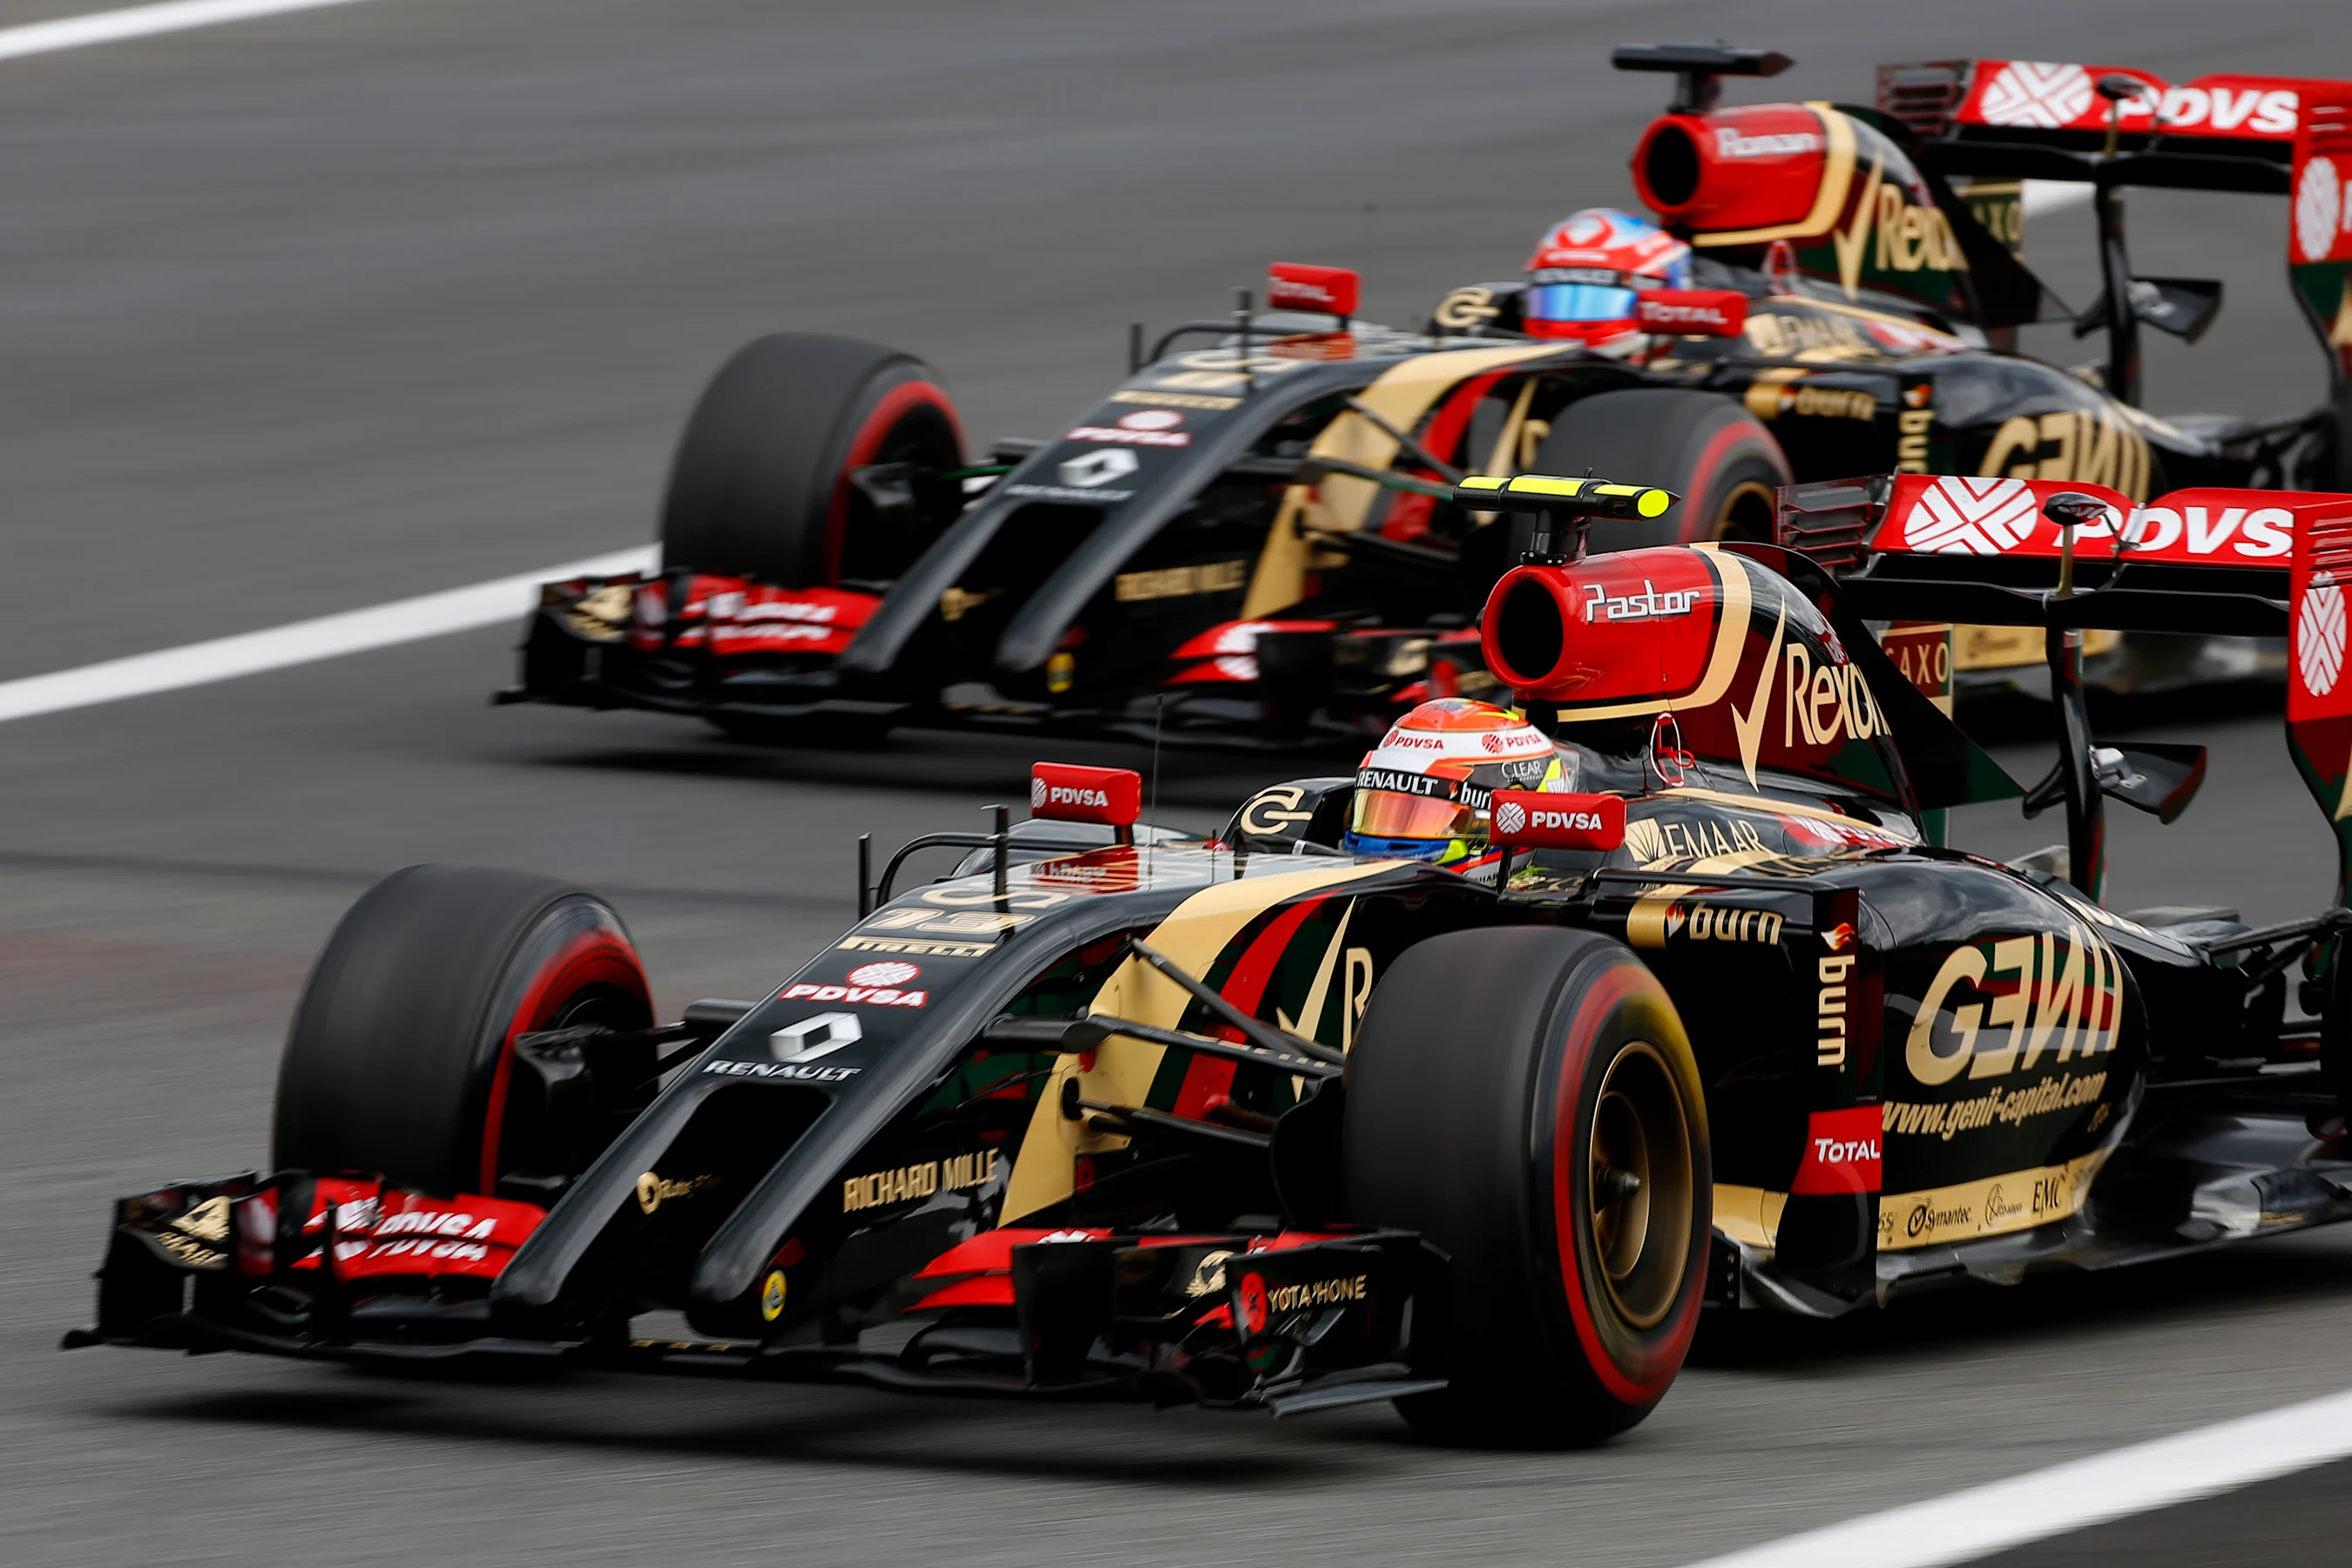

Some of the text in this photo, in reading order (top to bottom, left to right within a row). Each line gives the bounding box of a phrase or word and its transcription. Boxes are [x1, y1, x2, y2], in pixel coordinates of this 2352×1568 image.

[1639, 301, 1728, 324] TOTAL
[2051, 504, 2295, 558] PDVS
[1583, 579, 1700, 622] Pastor
[1885, 641, 1950, 685] AXO
[1395, 736, 1443, 750] PDVSA
[1506, 733, 1541, 747] PDVSA
[1502, 760, 1543, 779] CLEAR
[1356, 770, 1438, 795] RENAULT
[1051, 787, 1109, 807] PDVSA
[1531, 811, 1602, 830] PDVSA
[1689, 902, 1783, 945] burn
[835, 936, 997, 957] PIRELLI
[781, 983, 928, 1007] PDVSA
[1818, 954, 1855, 1066] burn
[702, 1059, 862, 1082] RENAULT
[1815, 1138, 1880, 1164] TOTAL
[843, 1147, 999, 1213] RICHARD MILLE
[1925, 1205, 1971, 1231] Symantec
